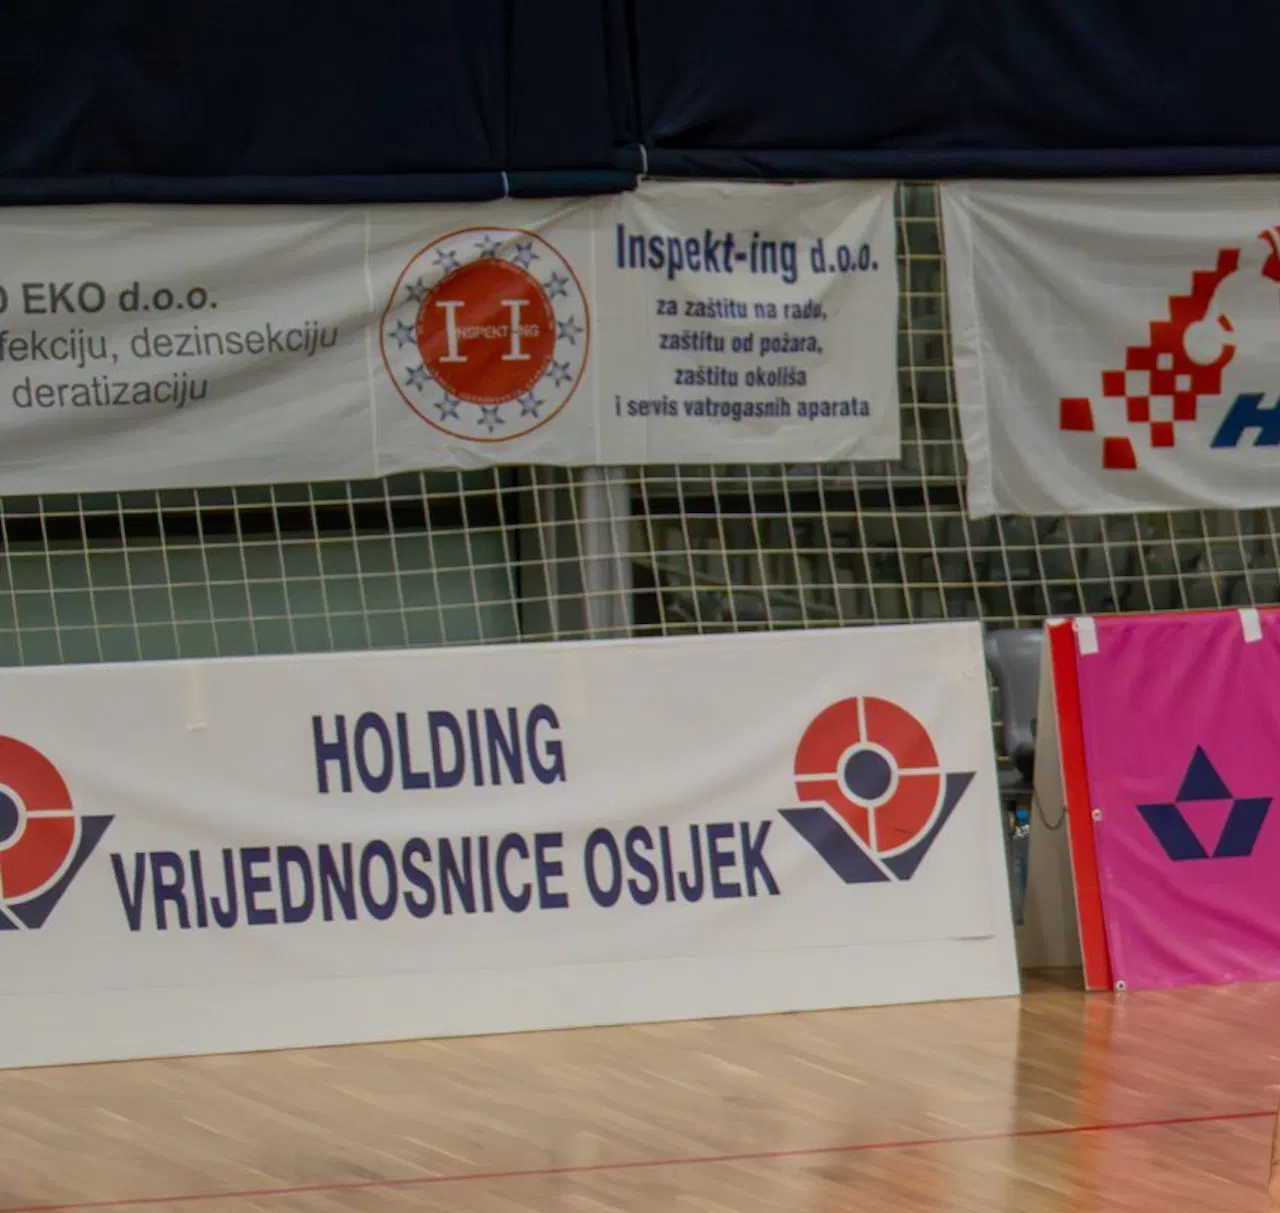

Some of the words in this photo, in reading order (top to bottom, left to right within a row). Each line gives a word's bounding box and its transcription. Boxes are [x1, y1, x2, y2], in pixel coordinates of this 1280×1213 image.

[616, 223, 798, 284] Inspekt-ing
[811, 237, 879, 273] d.o.o.
[22, 281, 106, 314] EKO
[118, 281, 218, 312] d.o.o.
[656, 299, 678, 316] za
[684, 299, 748, 319] zaštitu
[755, 302, 777, 319] na
[130, 320, 339, 358] dezinsekciju
[659, 330, 725, 350] zaštitu
[731, 331, 753, 352] od
[12, 372, 209, 409] deratizaciju
[674, 366, 739, 387] zaštitu
[615, 396, 621, 416] i
[796, 398, 869, 419] aparata
[312, 703, 567, 794] HOLDING
[110, 832, 569, 932] VRIJEDNOSNICE
[583, 819, 780, 908] OSIJEK
